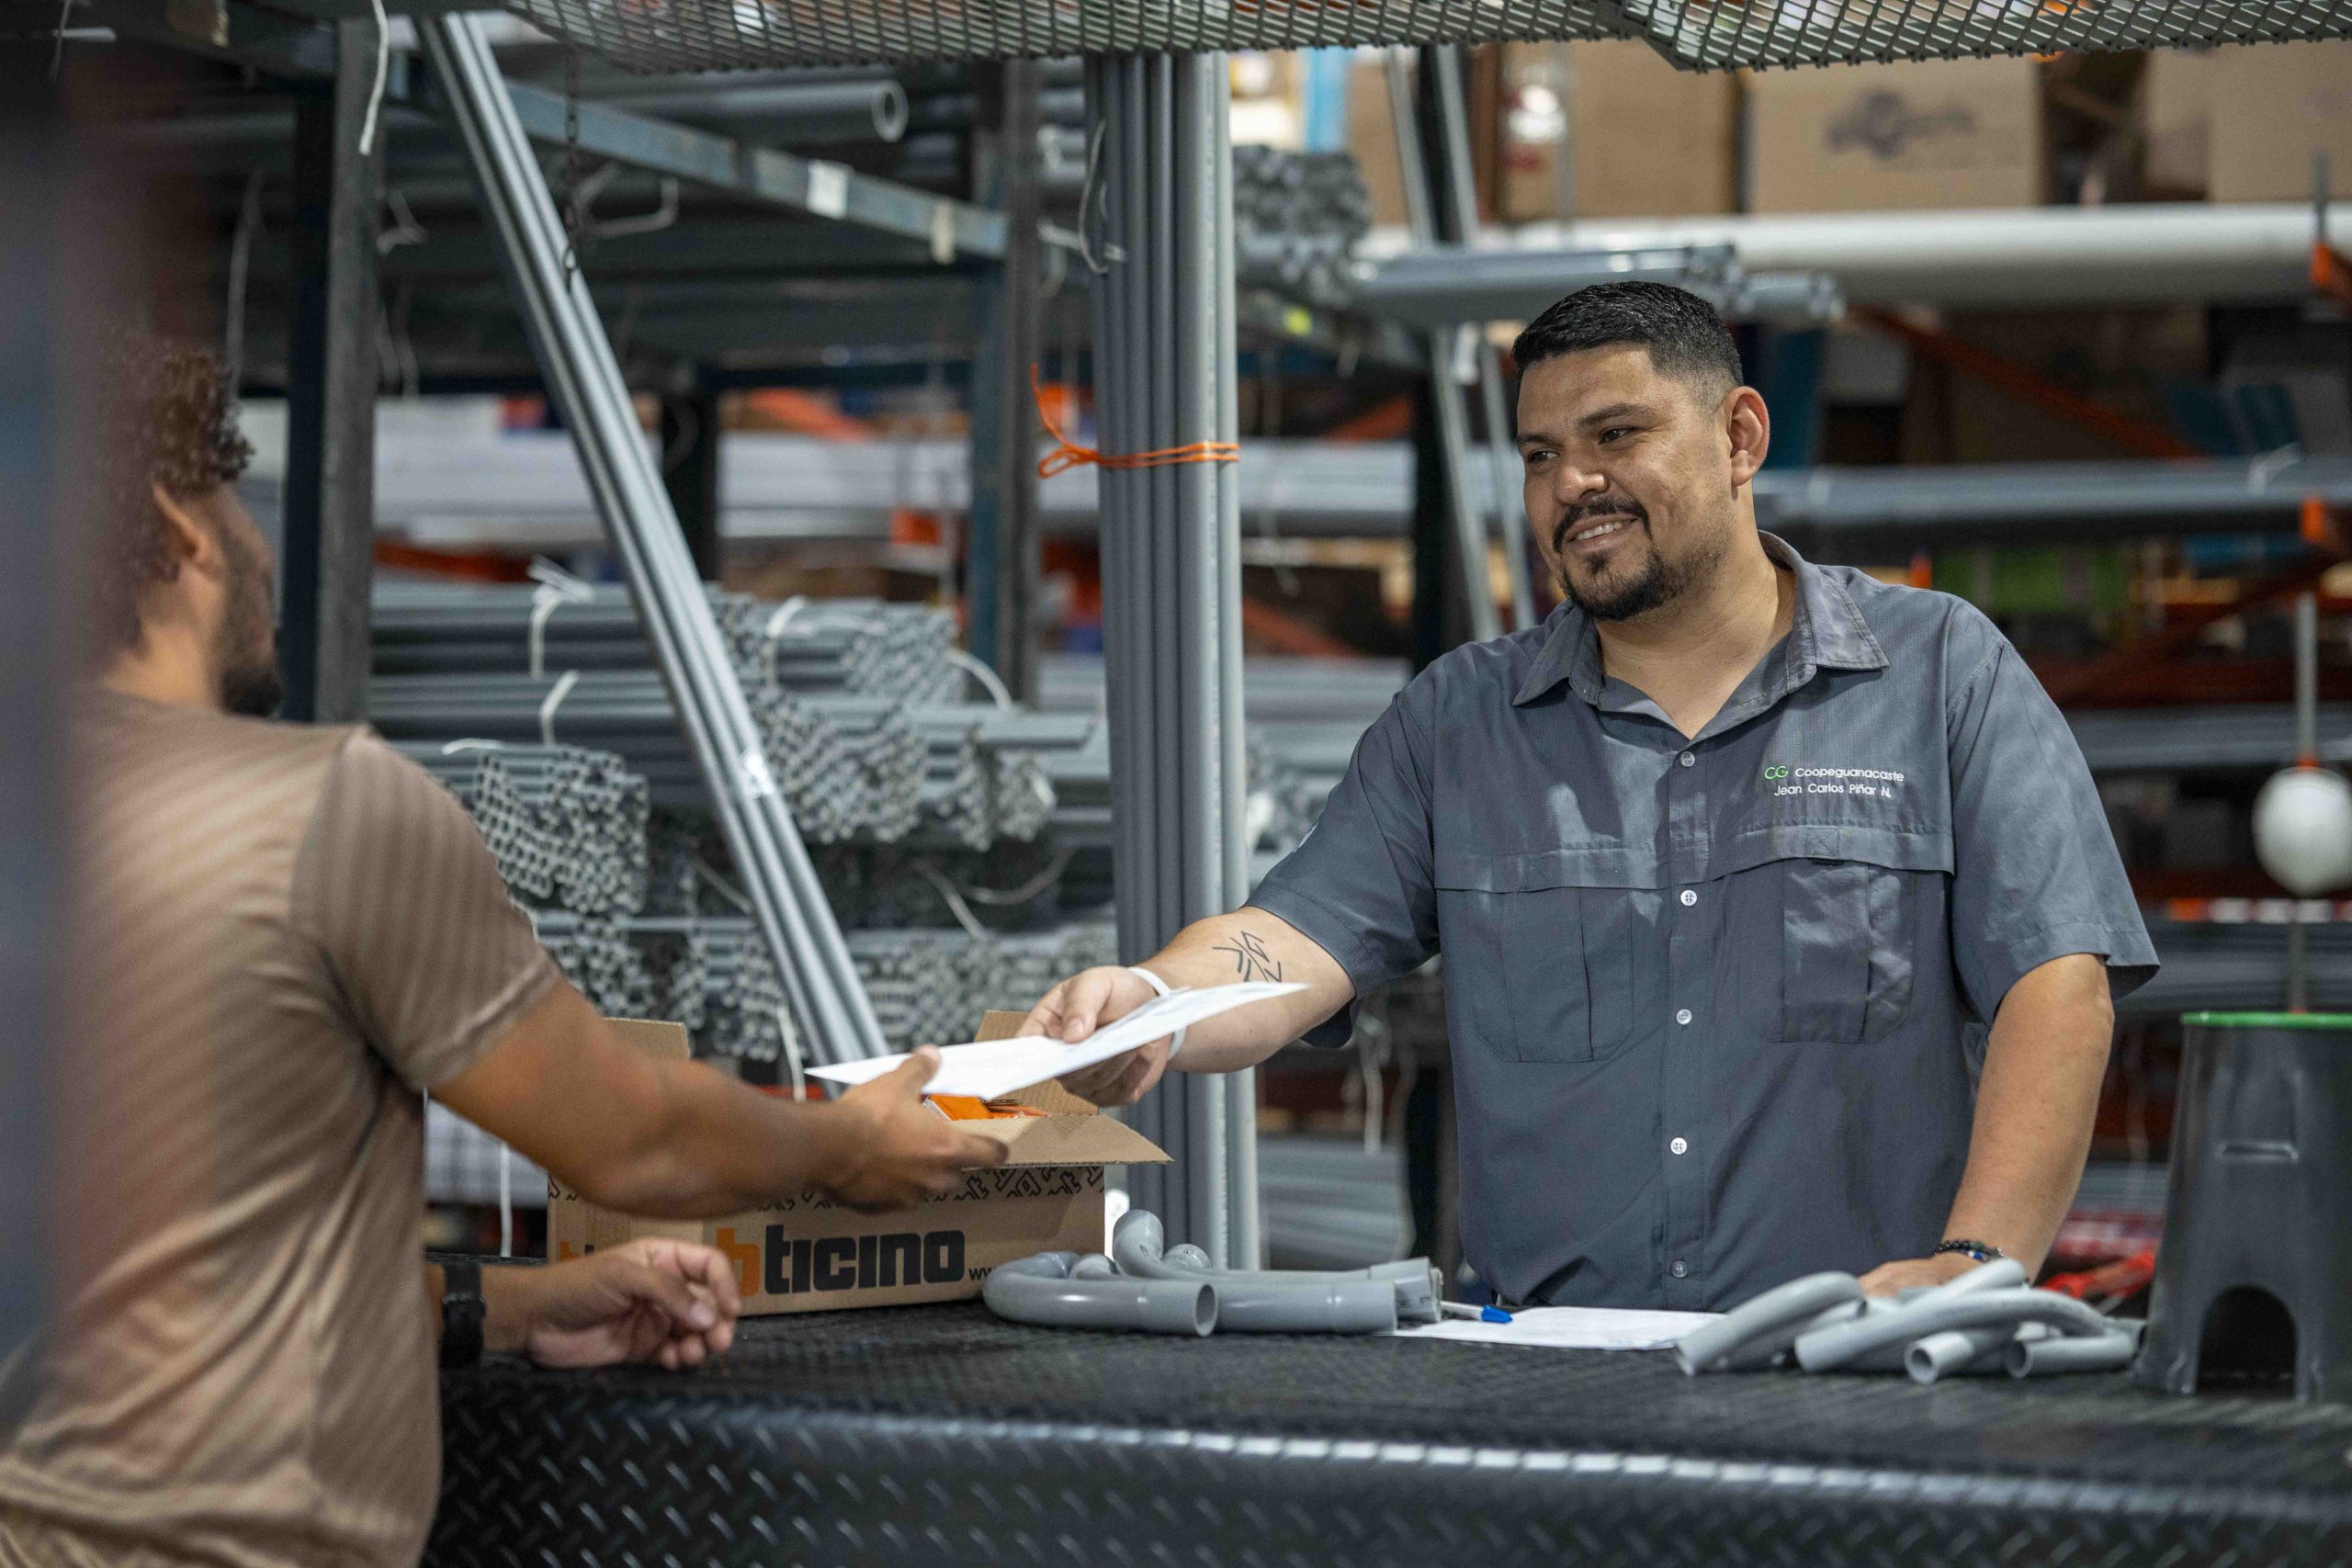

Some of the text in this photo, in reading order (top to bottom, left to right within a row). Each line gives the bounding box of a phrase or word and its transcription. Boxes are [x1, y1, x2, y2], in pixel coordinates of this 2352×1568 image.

[1794, 767, 1905, 782] Coopeguanacaste
[1774, 785, 1803, 796] Jean
[1807, 783, 1845, 794] Carlos
[1849, 784, 1877, 795] Piñar
[716, 1224, 966, 1296] bticino
